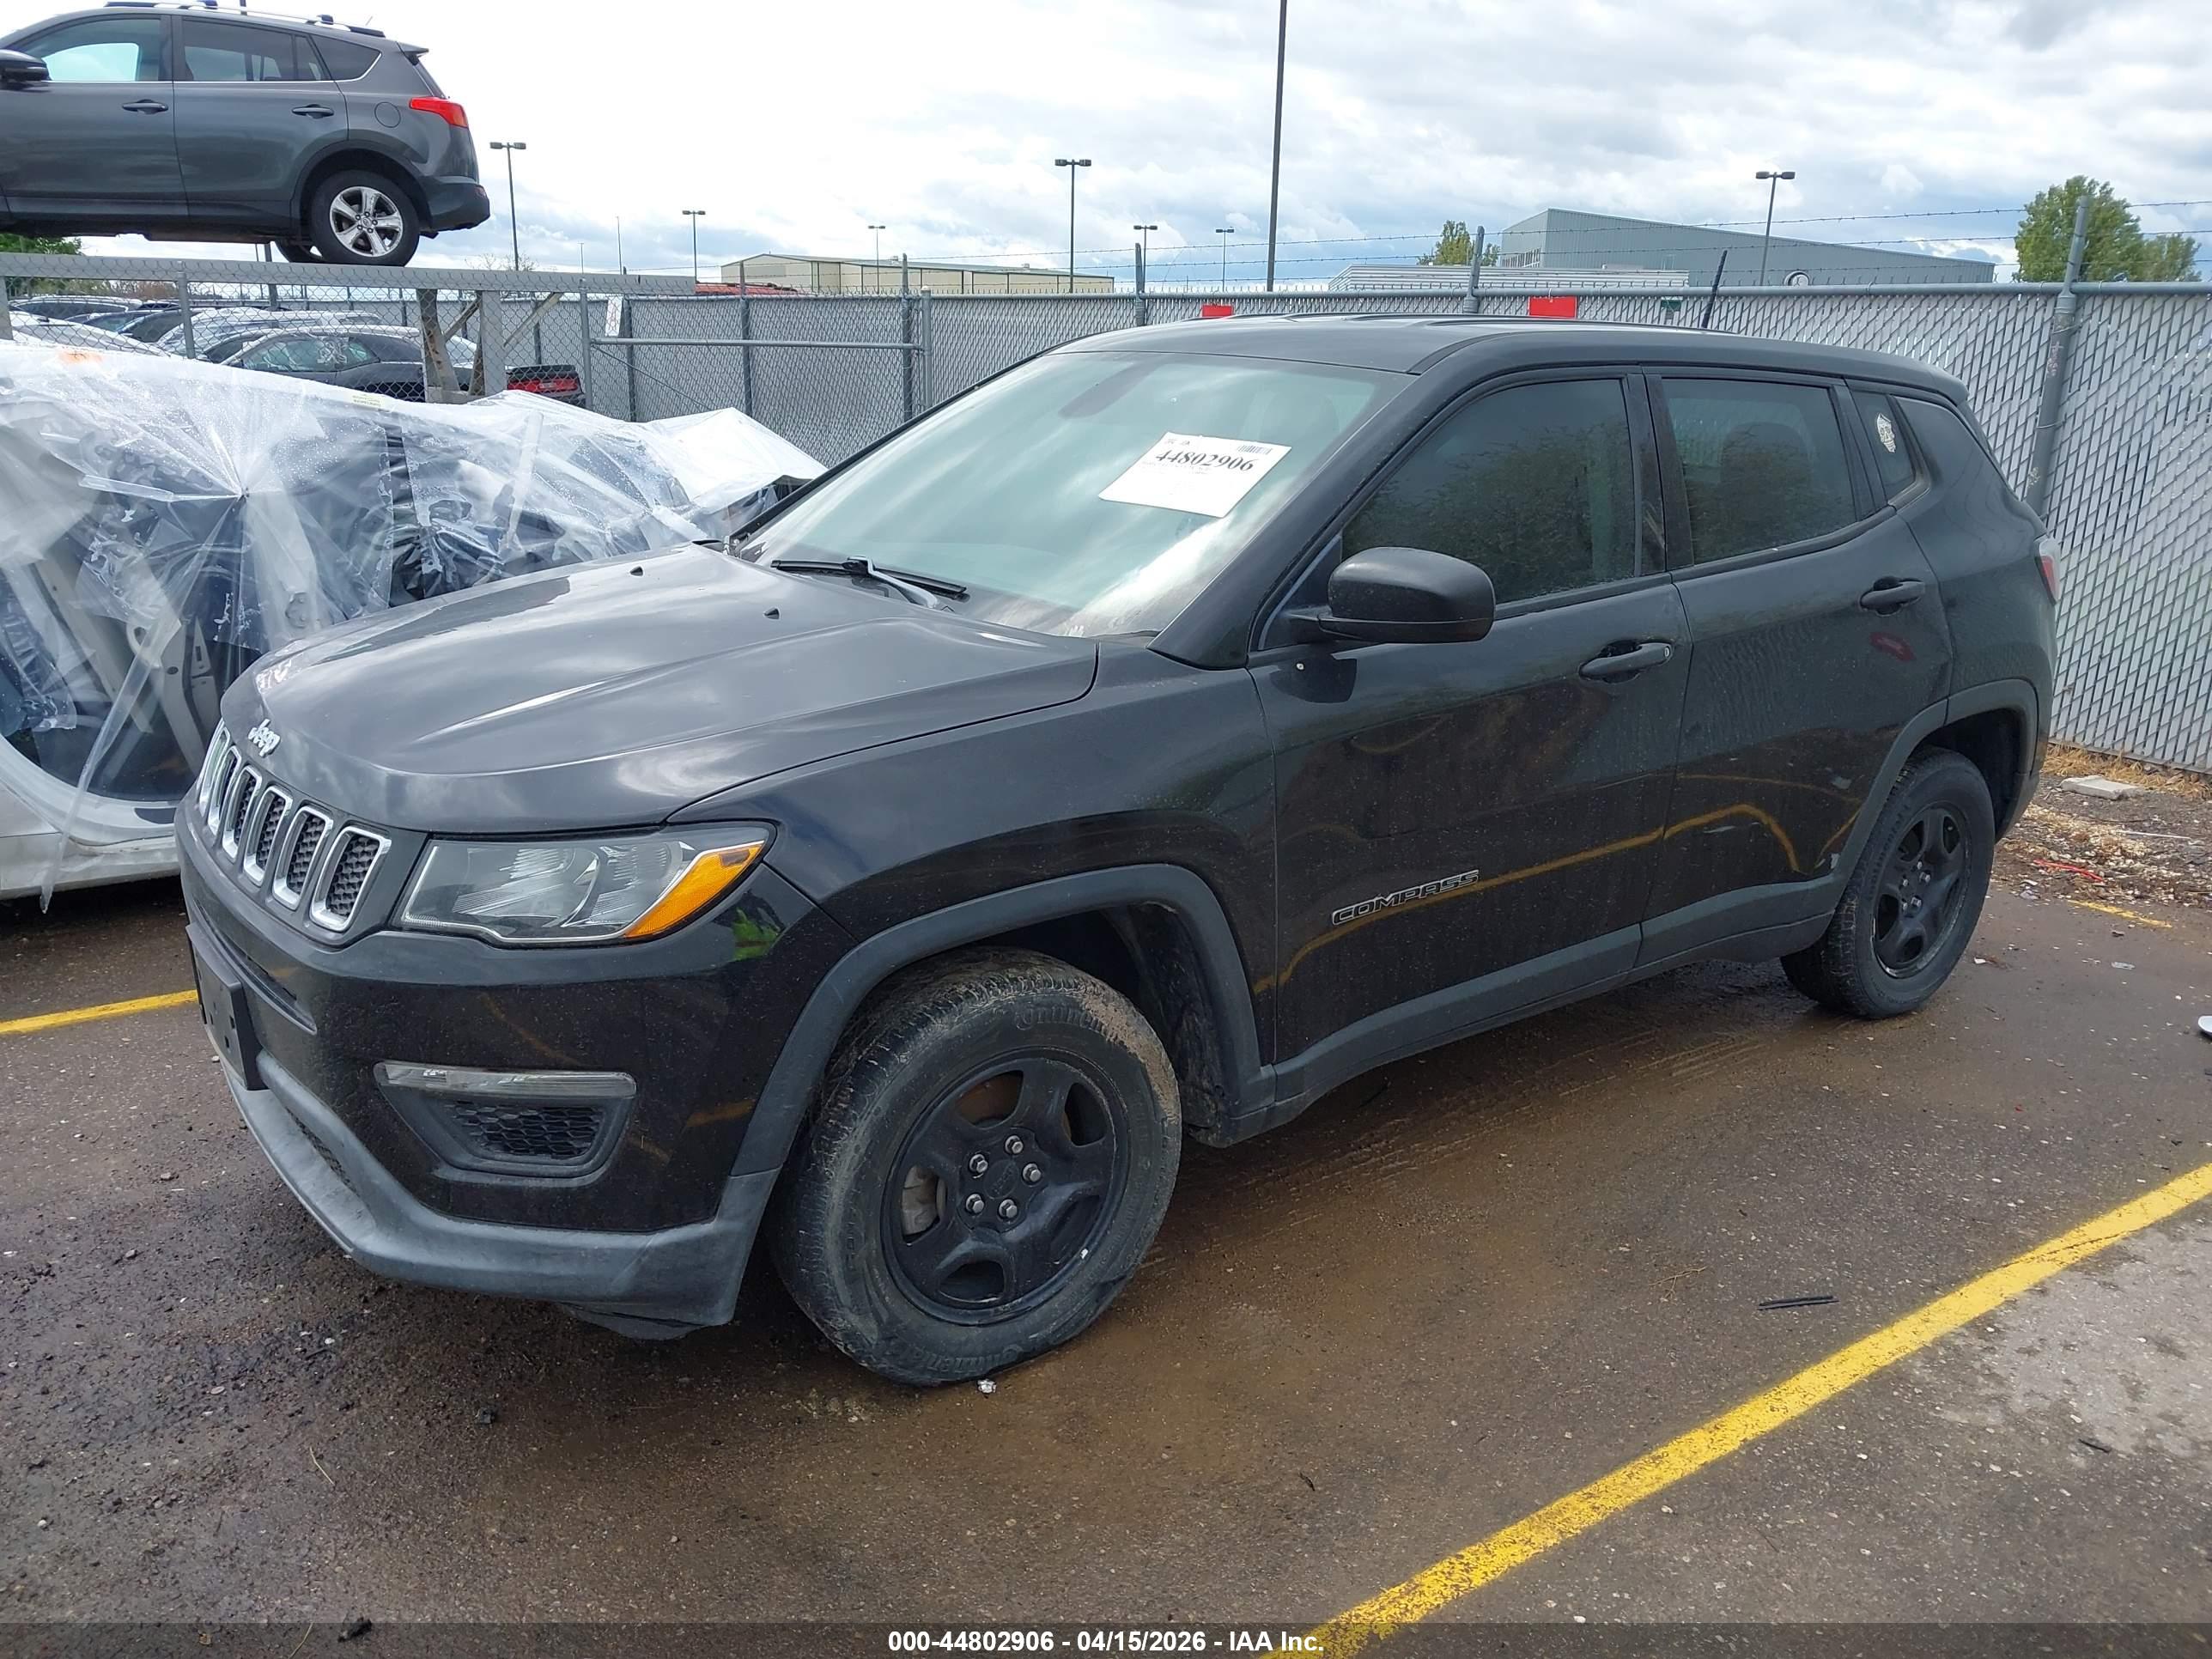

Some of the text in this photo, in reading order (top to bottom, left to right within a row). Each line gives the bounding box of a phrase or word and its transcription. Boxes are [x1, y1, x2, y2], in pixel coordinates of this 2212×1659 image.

[1156, 449, 1260, 471] 44802906
[248, 718, 281, 757] Jeep
[1332, 870, 1480, 926] COMPASS
